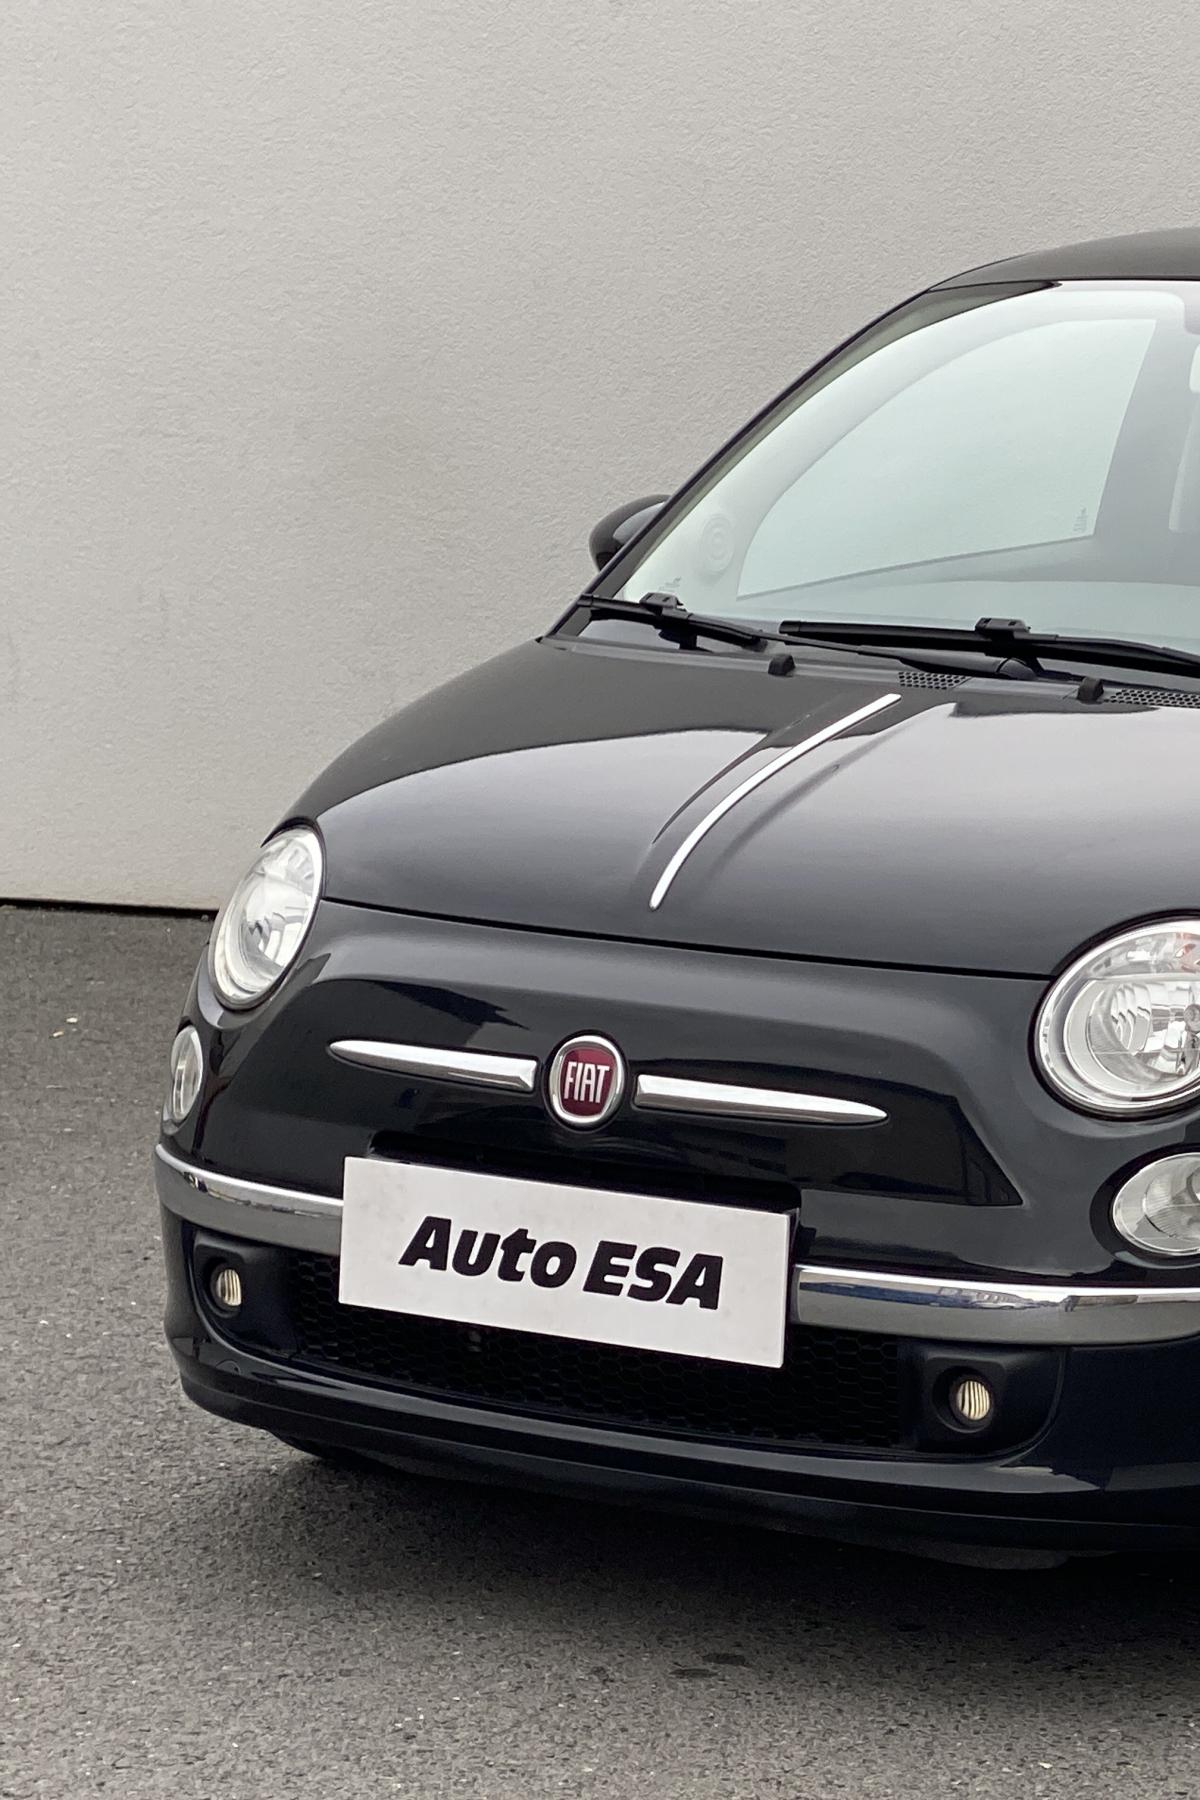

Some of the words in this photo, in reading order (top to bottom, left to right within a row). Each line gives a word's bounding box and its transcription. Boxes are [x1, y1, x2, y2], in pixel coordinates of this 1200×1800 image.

[563, 1061, 610, 1104] FIAT
[398, 1216, 577, 1289] Auto
[582, 1240, 724, 1311] ESA
